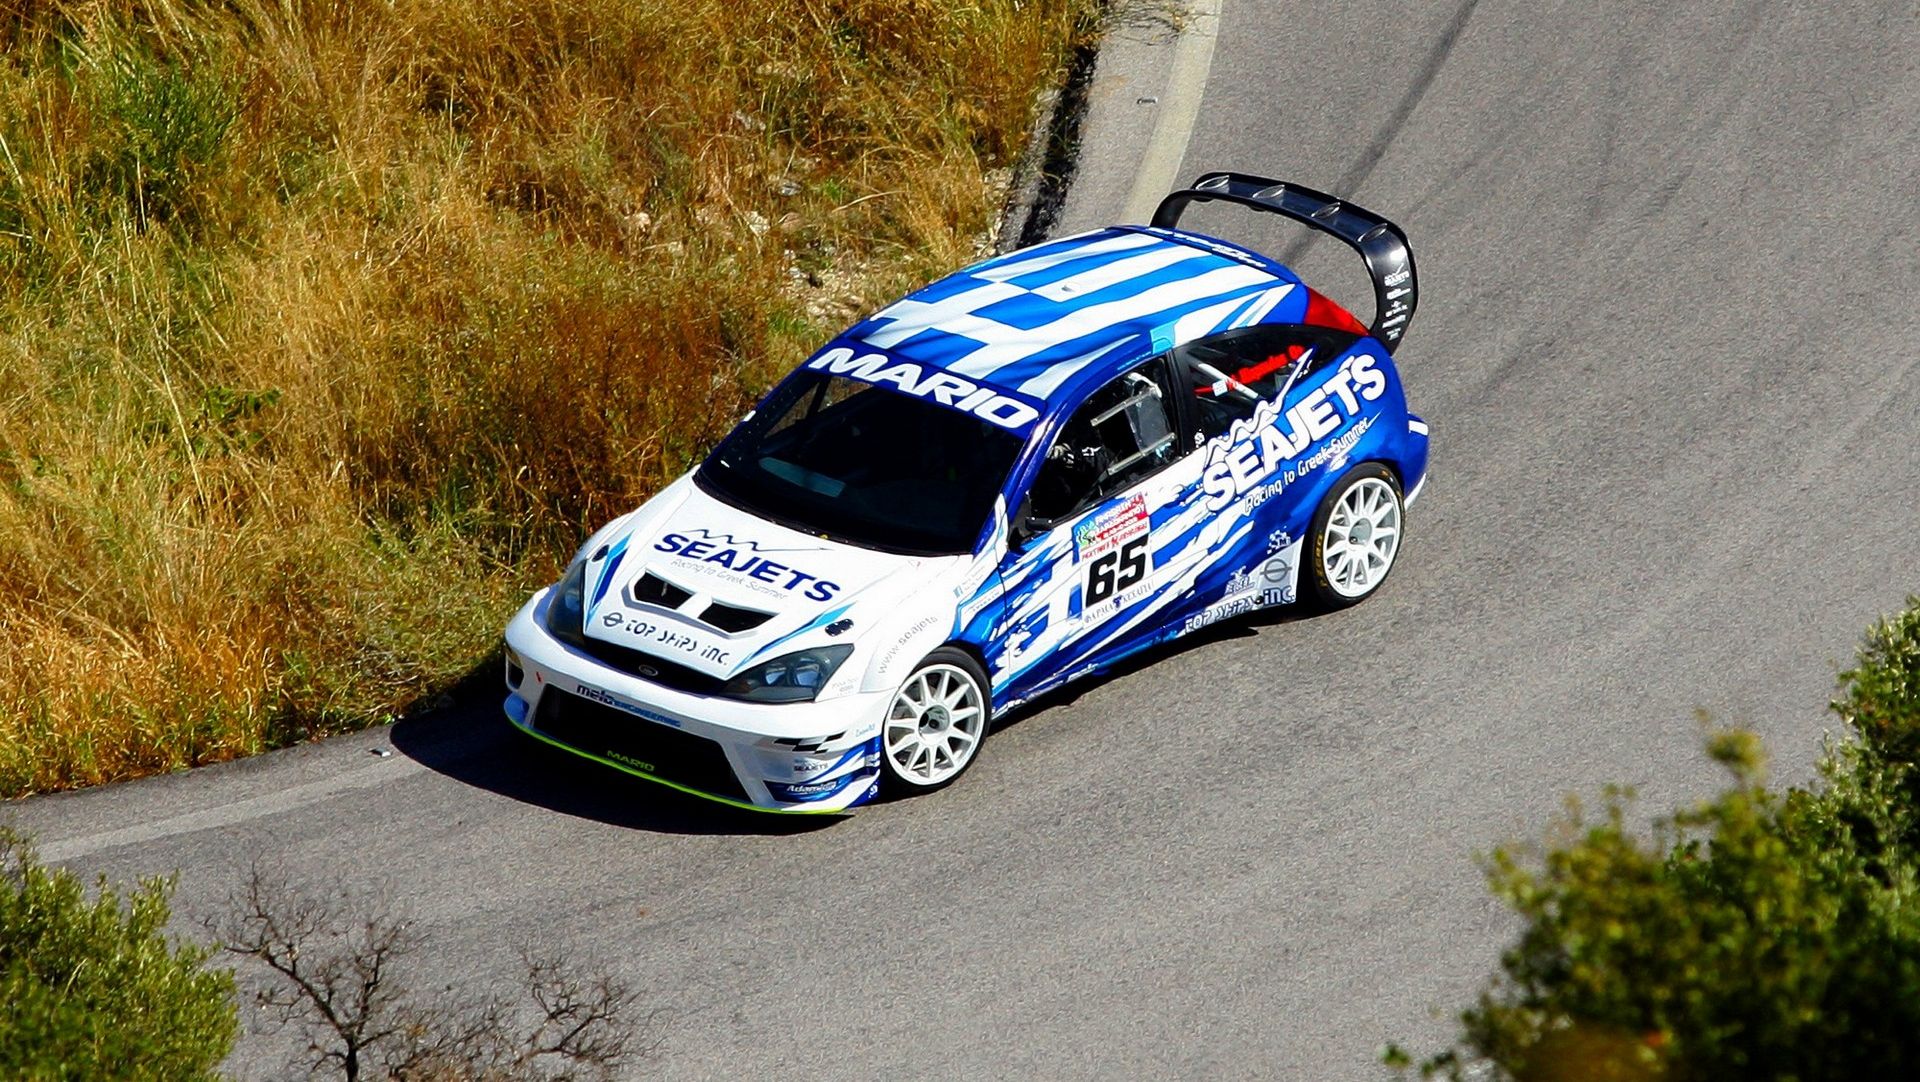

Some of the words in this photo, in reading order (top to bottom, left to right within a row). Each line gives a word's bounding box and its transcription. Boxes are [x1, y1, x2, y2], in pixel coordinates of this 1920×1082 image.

[808, 347, 1039, 429] MARIO
[1202, 353, 1386, 512] SEAJETS
[1244, 481, 1283, 513] Racing
[1283, 469, 1295, 486] to
[1297, 450, 1329, 477] Greek
[1330, 416, 1370, 453] Summer
[653, 533, 841, 602] SEAJETS
[703, 566, 716, 576] to
[1085, 532, 1150, 608] 65
[606, 749, 655, 772] MARIO
